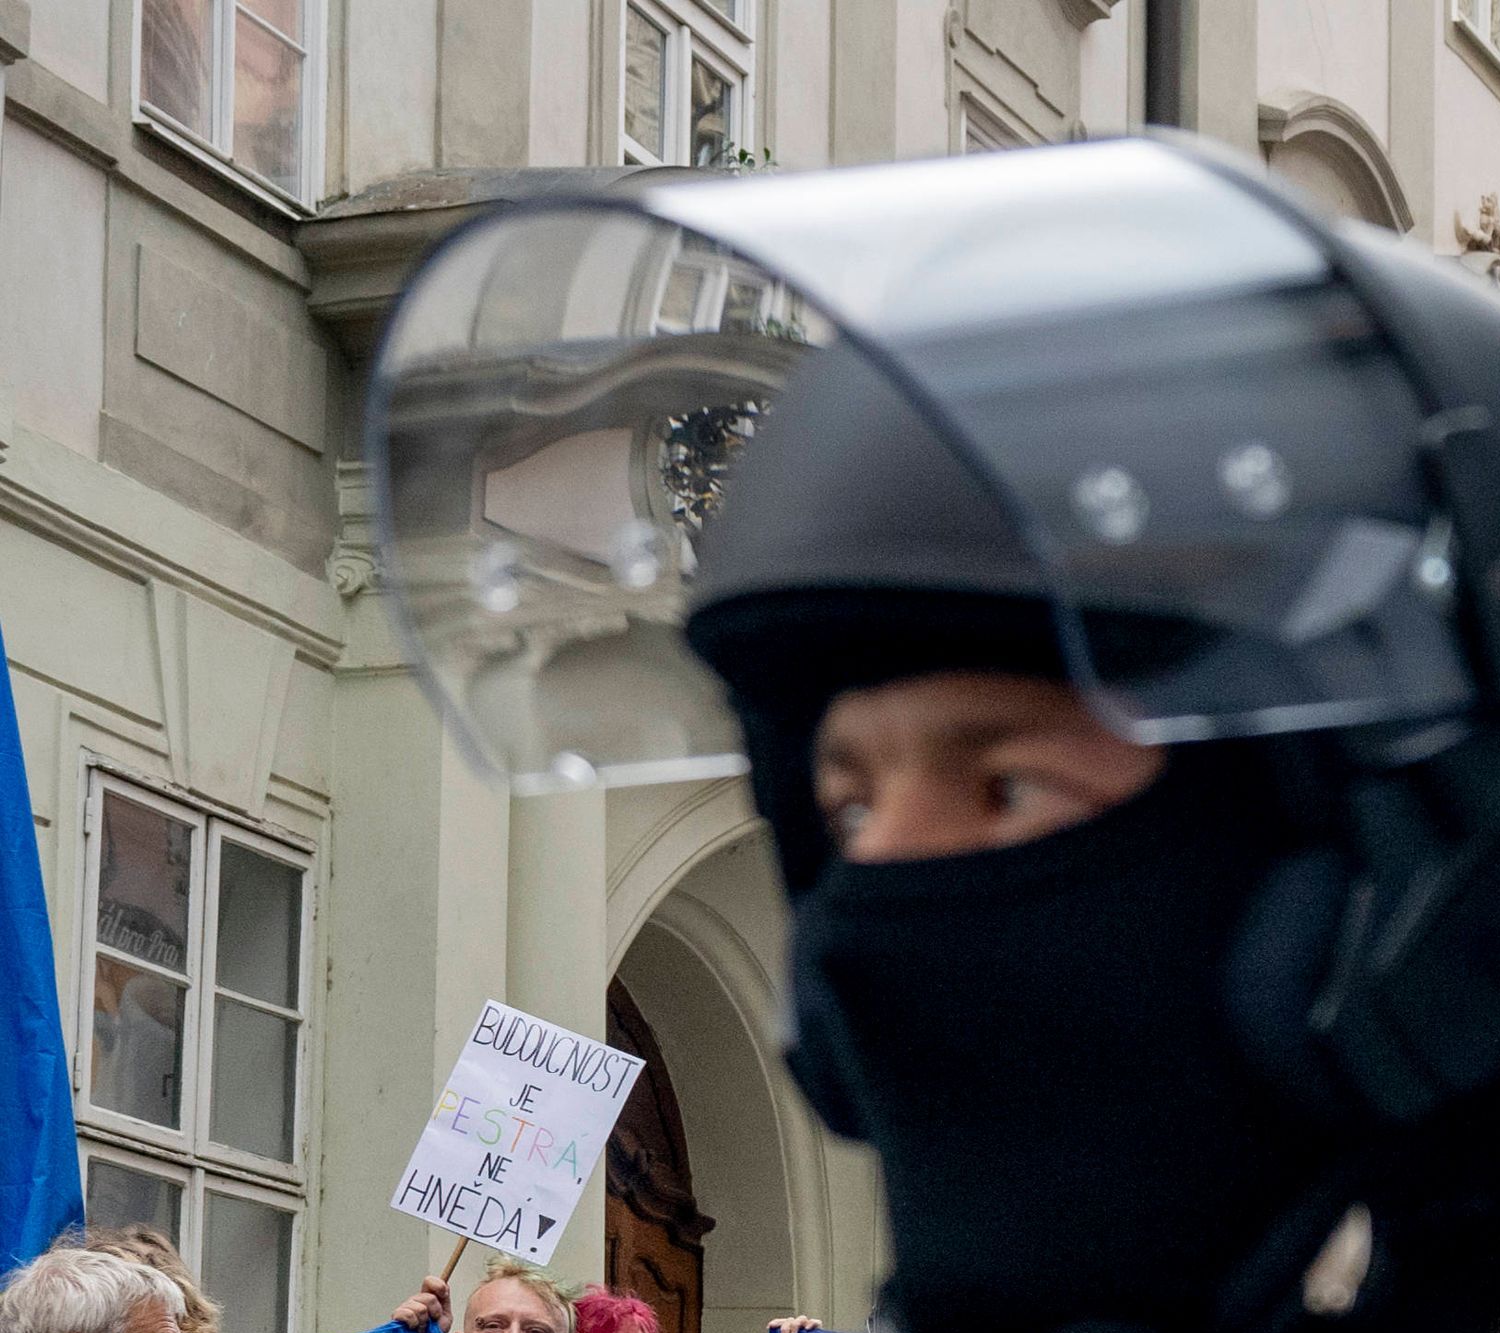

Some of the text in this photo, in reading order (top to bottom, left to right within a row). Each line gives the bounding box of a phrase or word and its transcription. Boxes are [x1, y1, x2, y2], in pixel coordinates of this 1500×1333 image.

[472, 1005, 639, 1099] BUDOUCNOST
[433, 1089, 589, 1185] PESTRÁ,
[509, 1084, 542, 1114] JE
[478, 1151, 513, 1184] NE
[399, 1168, 557, 1253] HNĚDÁ!
